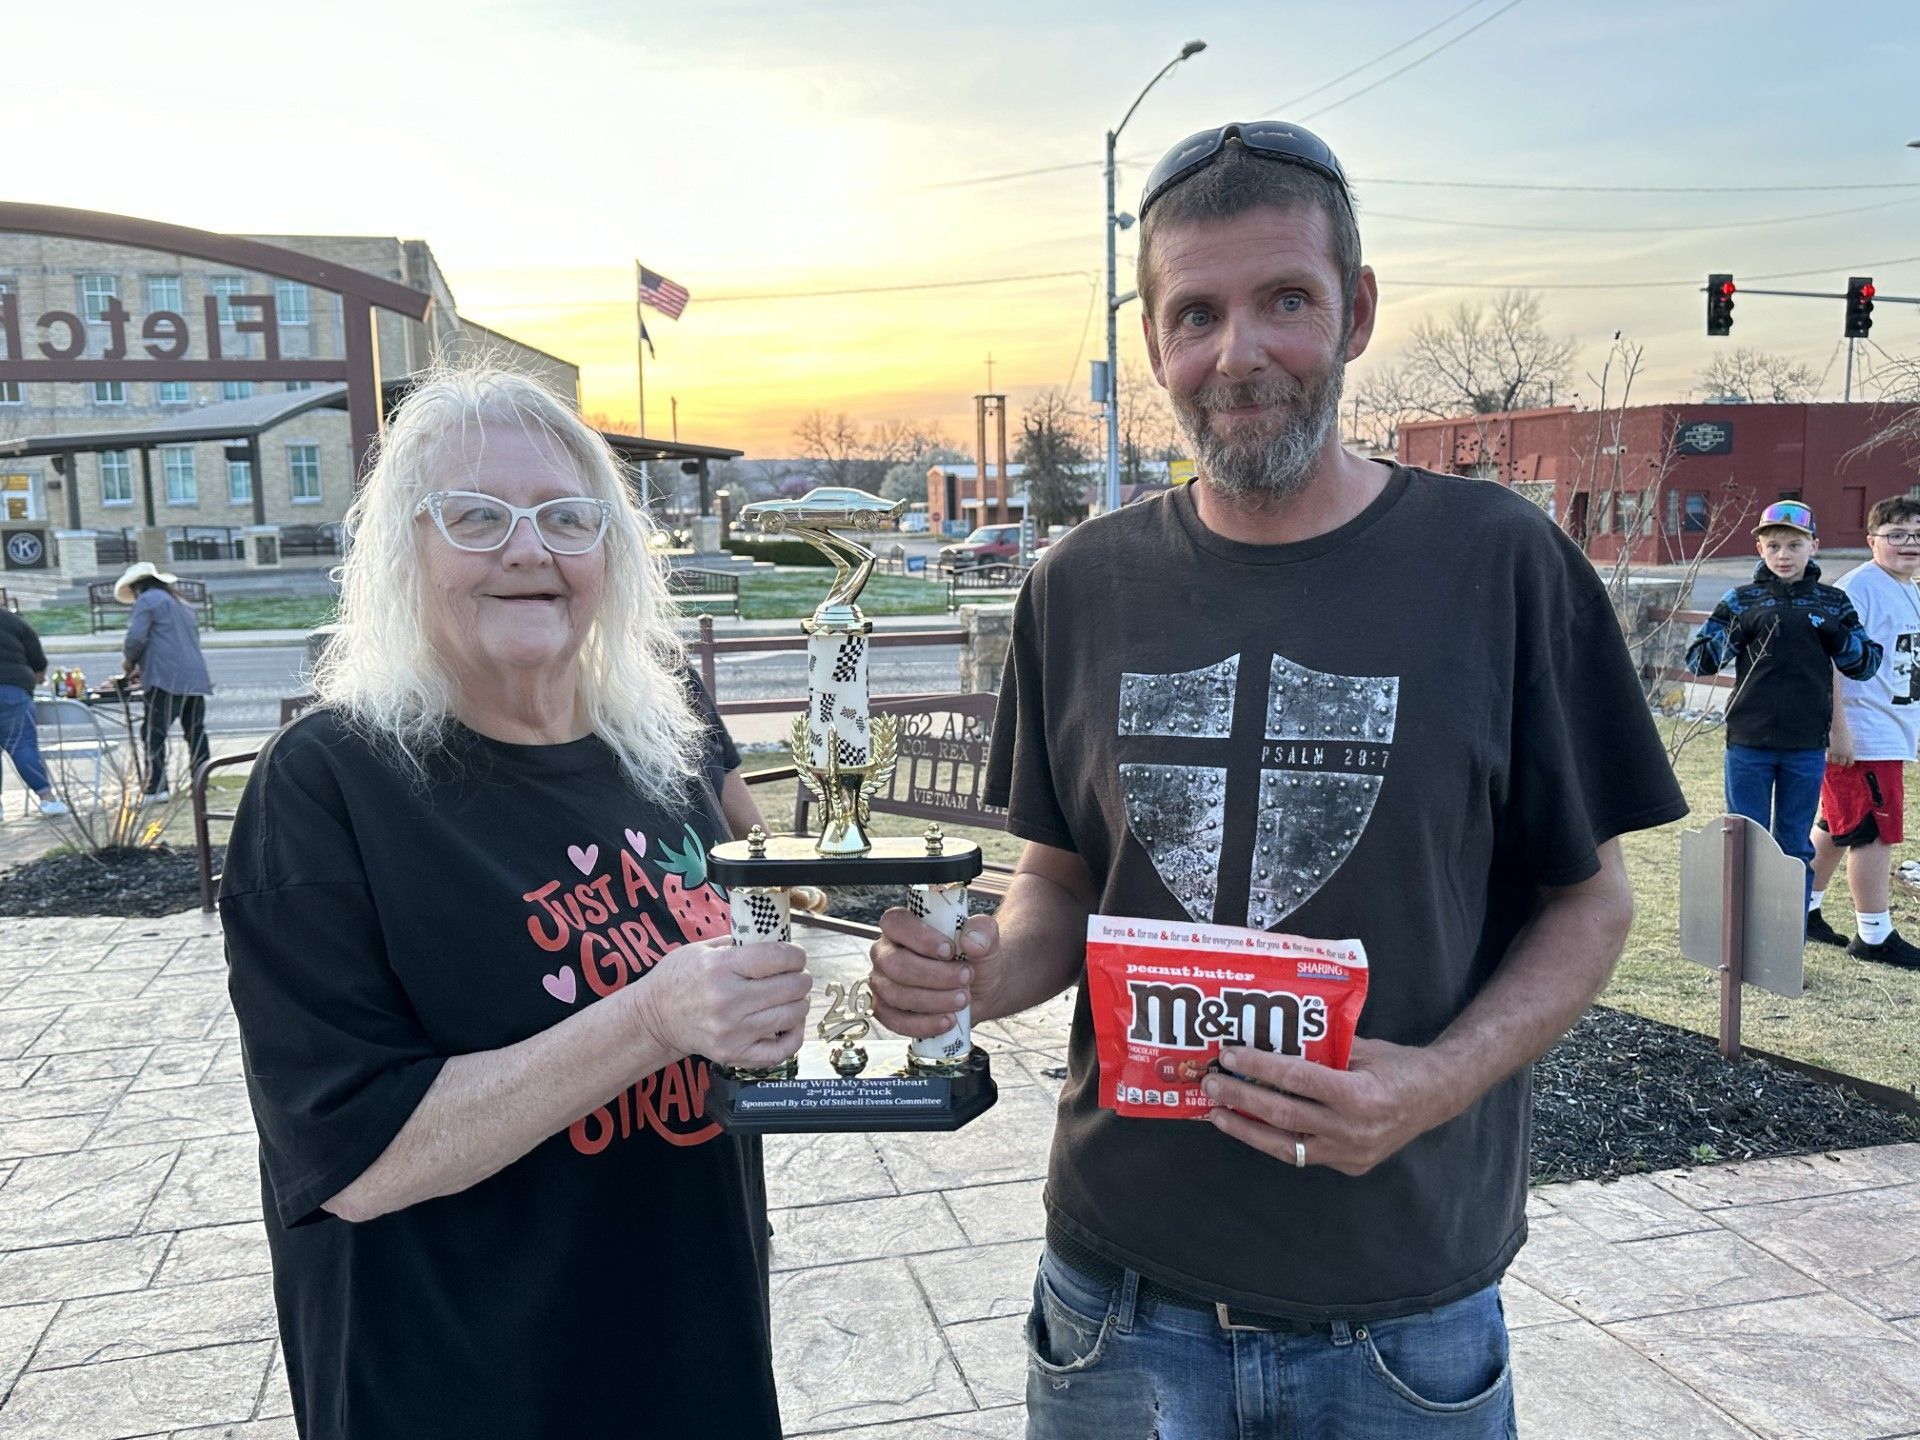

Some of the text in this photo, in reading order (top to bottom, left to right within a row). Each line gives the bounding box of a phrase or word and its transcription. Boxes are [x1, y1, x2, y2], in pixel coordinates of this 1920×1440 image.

[901, 738, 933, 757] COL.
[938, 742, 970, 761] REX
[1261, 746, 1389, 768] PSALM 28:7
[913, 789, 968, 810] VIETNAM
[522, 848, 659, 951] JUST A
[1103, 926, 1112, 936] for
[1113, 928, 1125, 937] you
[1127, 928, 1135, 937] &
[1137, 929, 1147, 938] for
[1147, 931, 1158, 939] me
[1160, 931, 1168, 940] &
[1170, 932, 1180, 941] for
[1191, 933, 1200, 943] &
[1202, 935, 1212, 944] for
[1212, 937, 1243, 948] everyone
[1245, 938, 1254, 947] &
[1256, 938, 1266, 947] for
[1267, 941, 1279, 950] you
[1338, 952, 1346, 960] us
[1348, 950, 1357, 960] &
[580, 912, 682, 997] GIRL
[1126, 963, 1255, 981] peanut butter
[1297, 961, 1342, 976] SHARING
[823, 977, 873, 1023] 26
[757, 1079, 929, 1089] Cruising With My Sweetheart
[823, 1088, 854, 1096] Place
[857, 1087, 892, 1096] Truck
[741, 1100, 786, 1109] Sponsored
[788, 1100, 799, 1108] By
[800, 1099, 818, 1107] City
[831, 1098, 863, 1106] Stilwell
[894, 1097, 941, 1105] Committee
